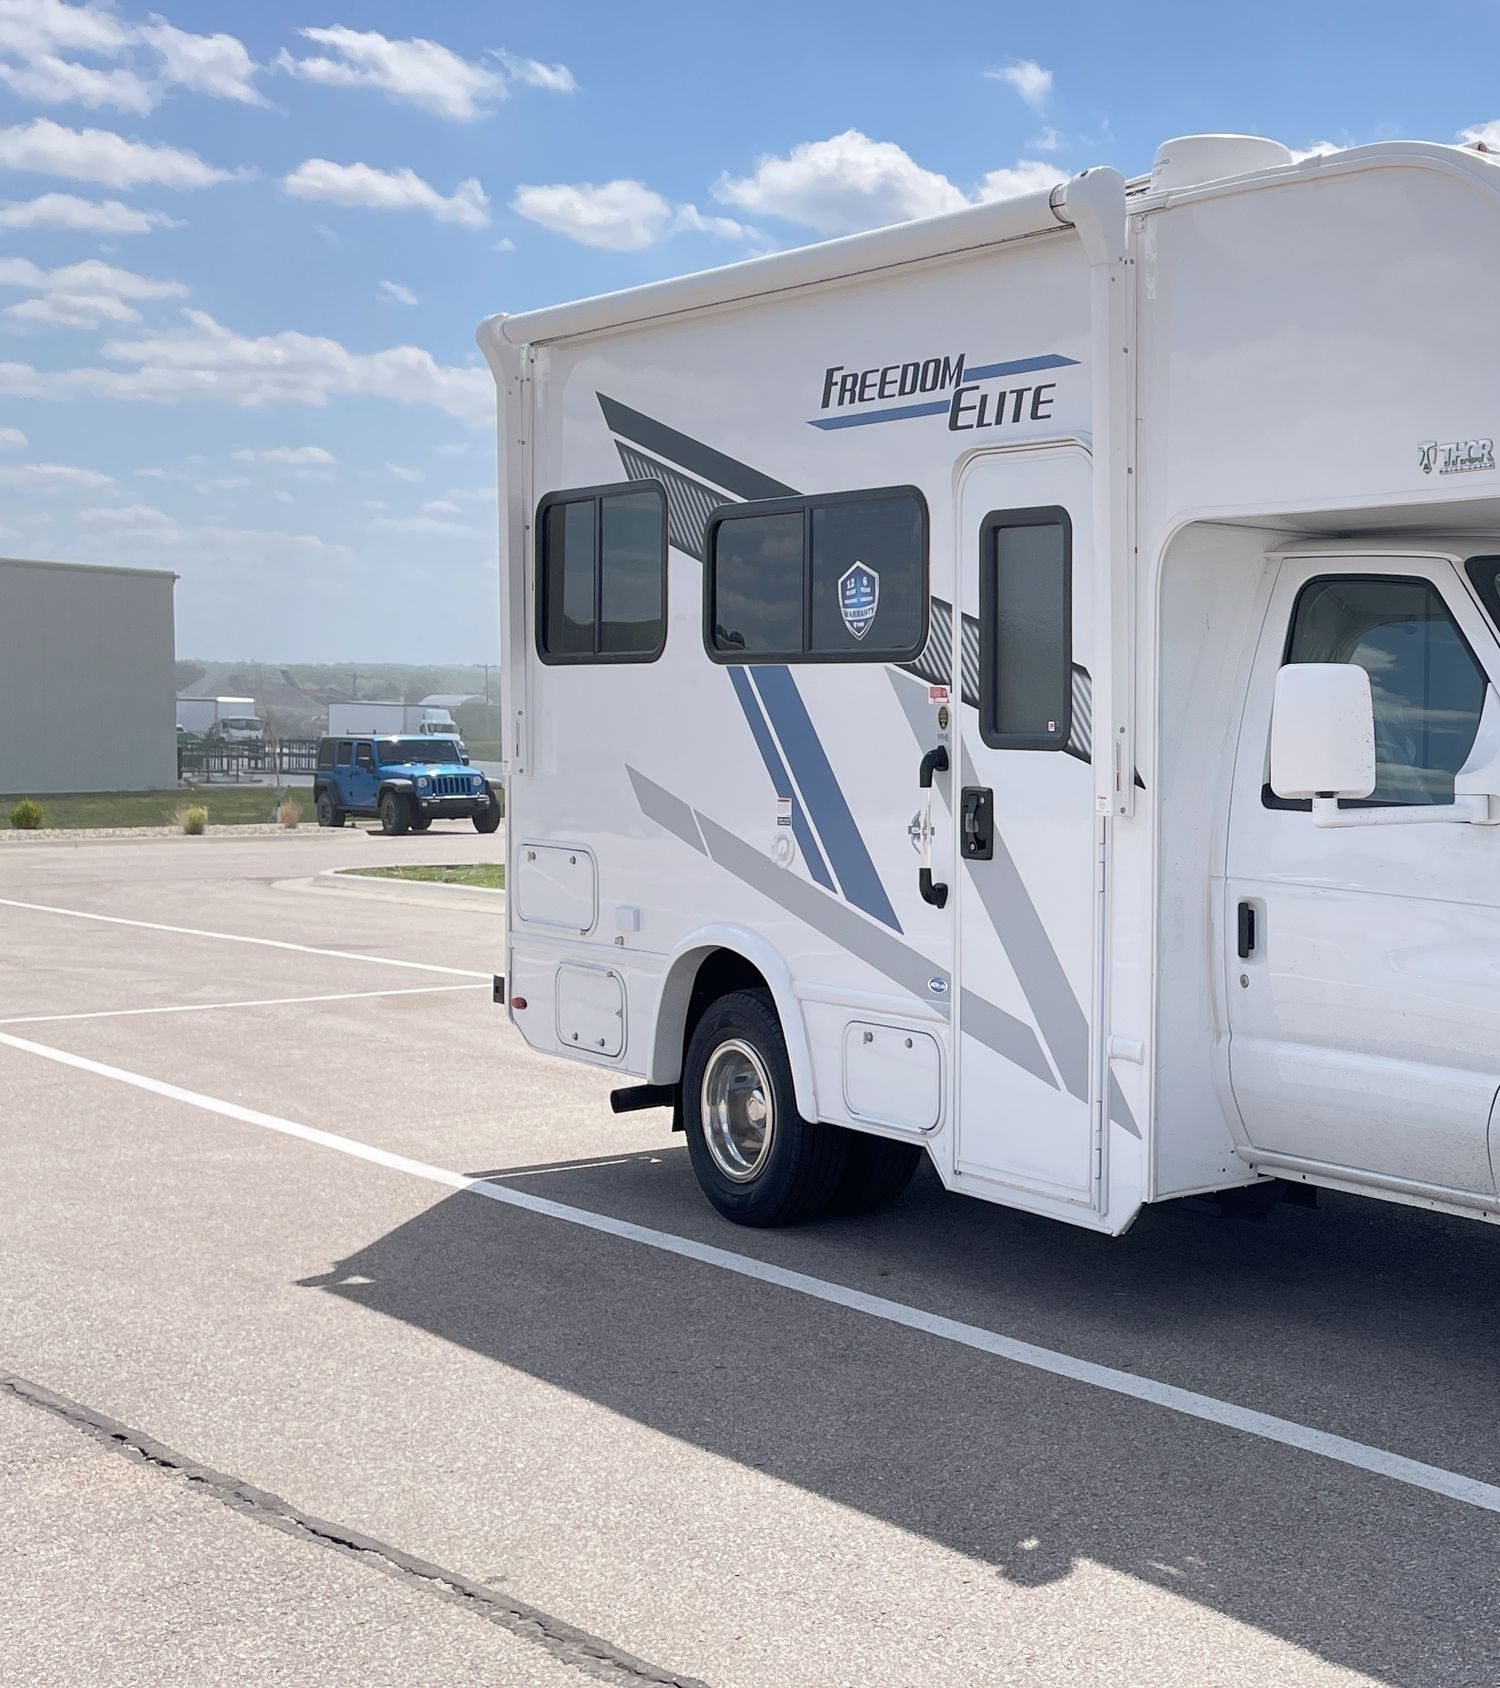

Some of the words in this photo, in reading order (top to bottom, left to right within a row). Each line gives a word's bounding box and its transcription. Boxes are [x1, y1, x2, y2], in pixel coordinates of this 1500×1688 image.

[821, 353, 965, 409] FREEDOM
[948, 383, 1056, 431] ELITE
[1439, 439, 1494, 466] THOR
[843, 607, 875, 618] WARRANTY
